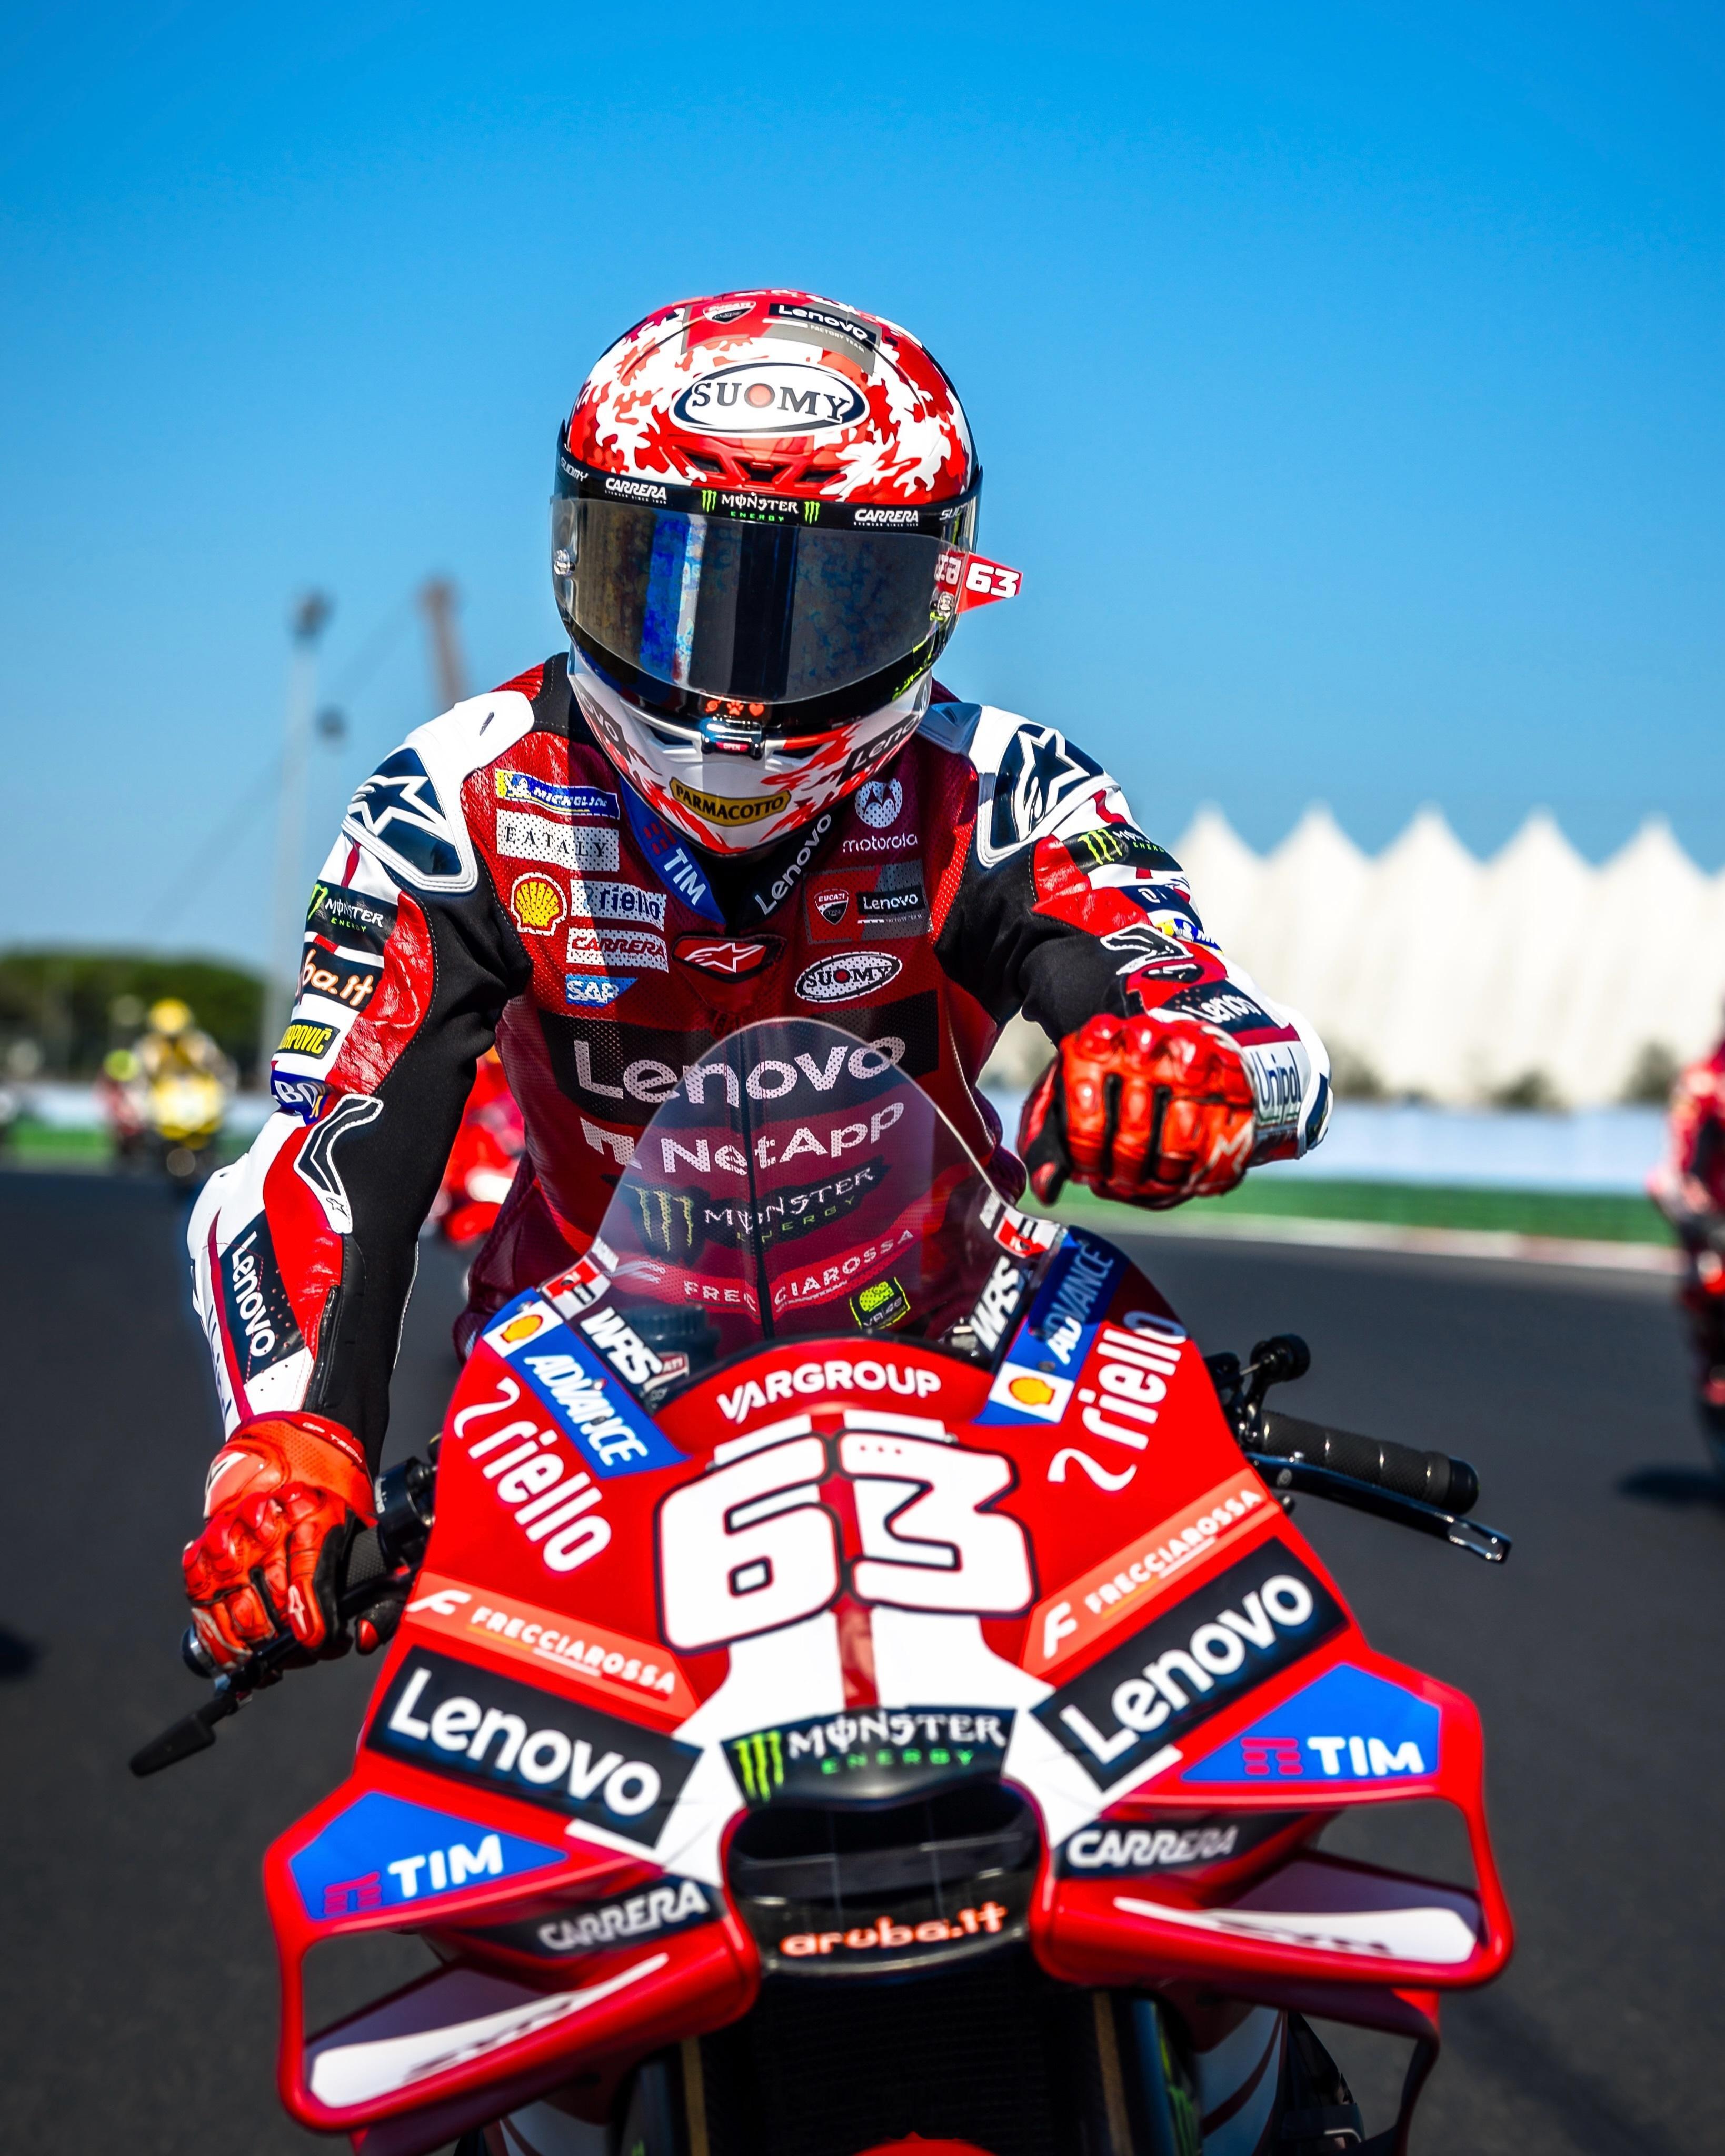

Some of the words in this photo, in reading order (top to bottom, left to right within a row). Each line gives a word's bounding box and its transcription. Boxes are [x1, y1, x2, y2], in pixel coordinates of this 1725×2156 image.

[779, 304, 868, 341] Lenovo
[811, 325, 844, 340] FACTORY
[846, 337, 865, 353] TEAM
[692, 382, 850, 421] SUOMY
[560, 457, 589, 482] SUOMY
[605, 477, 667, 500] CARRERA
[721, 492, 799, 514] MONSTER
[731, 511, 784, 522] ENERGY
[854, 508, 919, 523] CARRERA
[965, 562, 1020, 598] 63
[533, 788, 607, 807] MICHELIN
[675, 786, 784, 820] PARMACOTTO
[505, 826, 607, 857] EATALY
[754, 814, 832, 915] Lenovo
[843, 833, 918, 853] motorola
[664, 848, 706, 906] TIM
[819, 893, 845, 902] DUCATI
[325, 898, 384, 927] MONSTER
[331, 917, 367, 932] ENERGY
[600, 885, 660, 920] riello
[863, 894, 918, 910] Lenovo
[572, 937, 666, 960] CARRERA
[300, 949, 374, 1006] ba.it
[567, 980, 619, 1004] SAP
[805, 965, 892, 987] SUOMY
[574, 1035, 906, 1108] Lenovo
[1250, 1046, 1301, 1124] Unipol
[661, 1102, 905, 1176] NetApp
[704, 1167, 876, 1234] MONSTER
[737, 1196, 855, 1244] ENERGY
[232, 1230, 276, 1358] Lenovo
[969, 1255, 1020, 1352] WRS
[1043, 1238, 1114, 1366] ADVANCE
[580, 1306, 663, 1385] WRS
[716, 1361, 942, 1423] VARGROUP
[1077, 1310, 1188, 1451] riello
[524, 1354, 649, 1466] ADVANCE
[468, 1420, 612, 1572] riello
[658, 1429, 1036, 1651] 63
[1083, 1490, 1262, 1614] FRECCIAROSSA
[470, 1606, 676, 1694] FRECCIAROSSA
[1059, 1574, 1314, 1765] Lenovo
[387, 1667, 661, 1816] Lenovo
[787, 1709, 1006, 1759] MONSTER
[1307, 1736, 1425, 1776] TIM
[821, 1748, 974, 1775] ENERGY
[387, 1833, 504, 1898] TIM
[1066, 1825, 1239, 1868] CARRERA
[537, 1879, 710, 1950] CARRERA
[780, 1900, 1009, 1957] aruba.it
